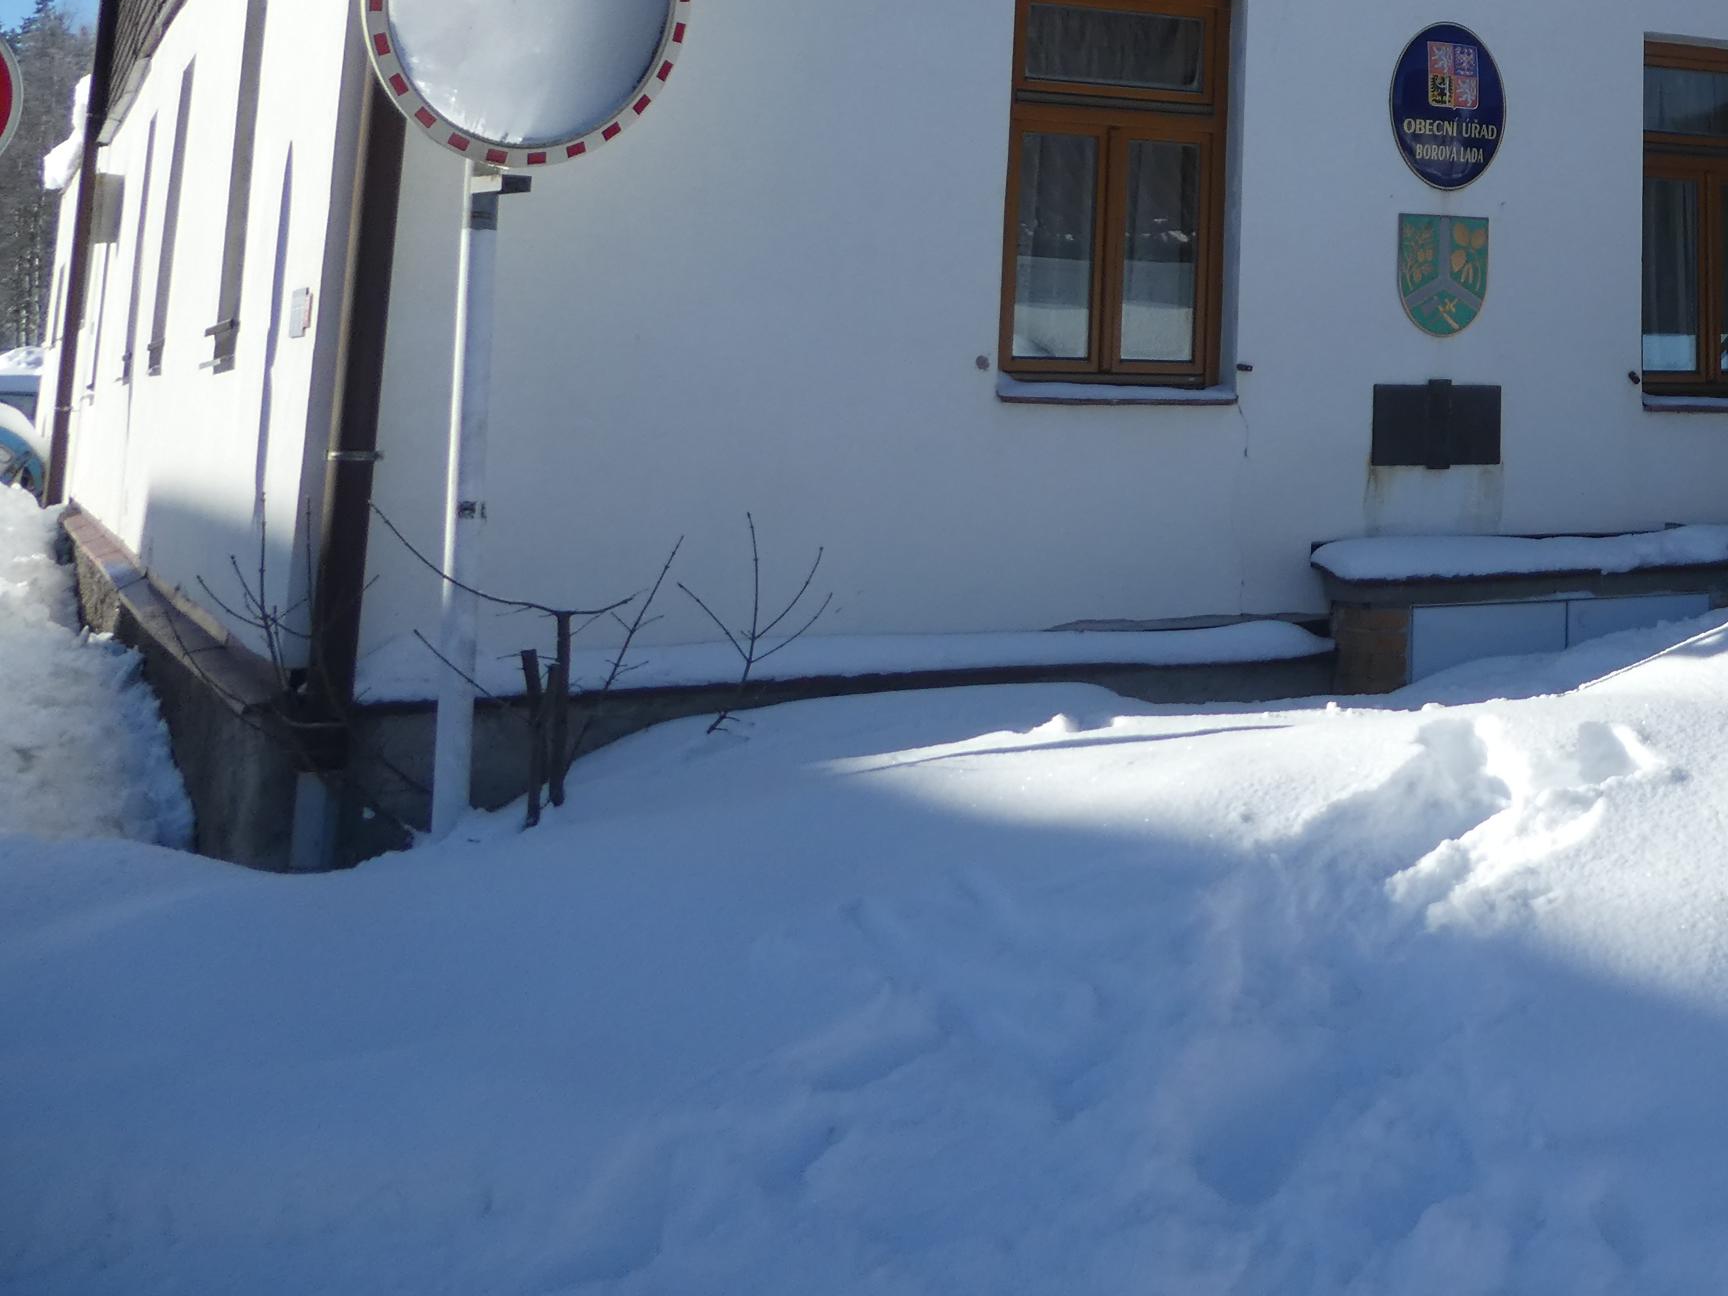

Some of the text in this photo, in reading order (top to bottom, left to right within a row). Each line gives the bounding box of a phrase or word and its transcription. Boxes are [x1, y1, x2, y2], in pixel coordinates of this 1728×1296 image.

[1403, 116, 1498, 140] OBECNÍ ÚŘAD
[1460, 147, 1484, 164] LADA
